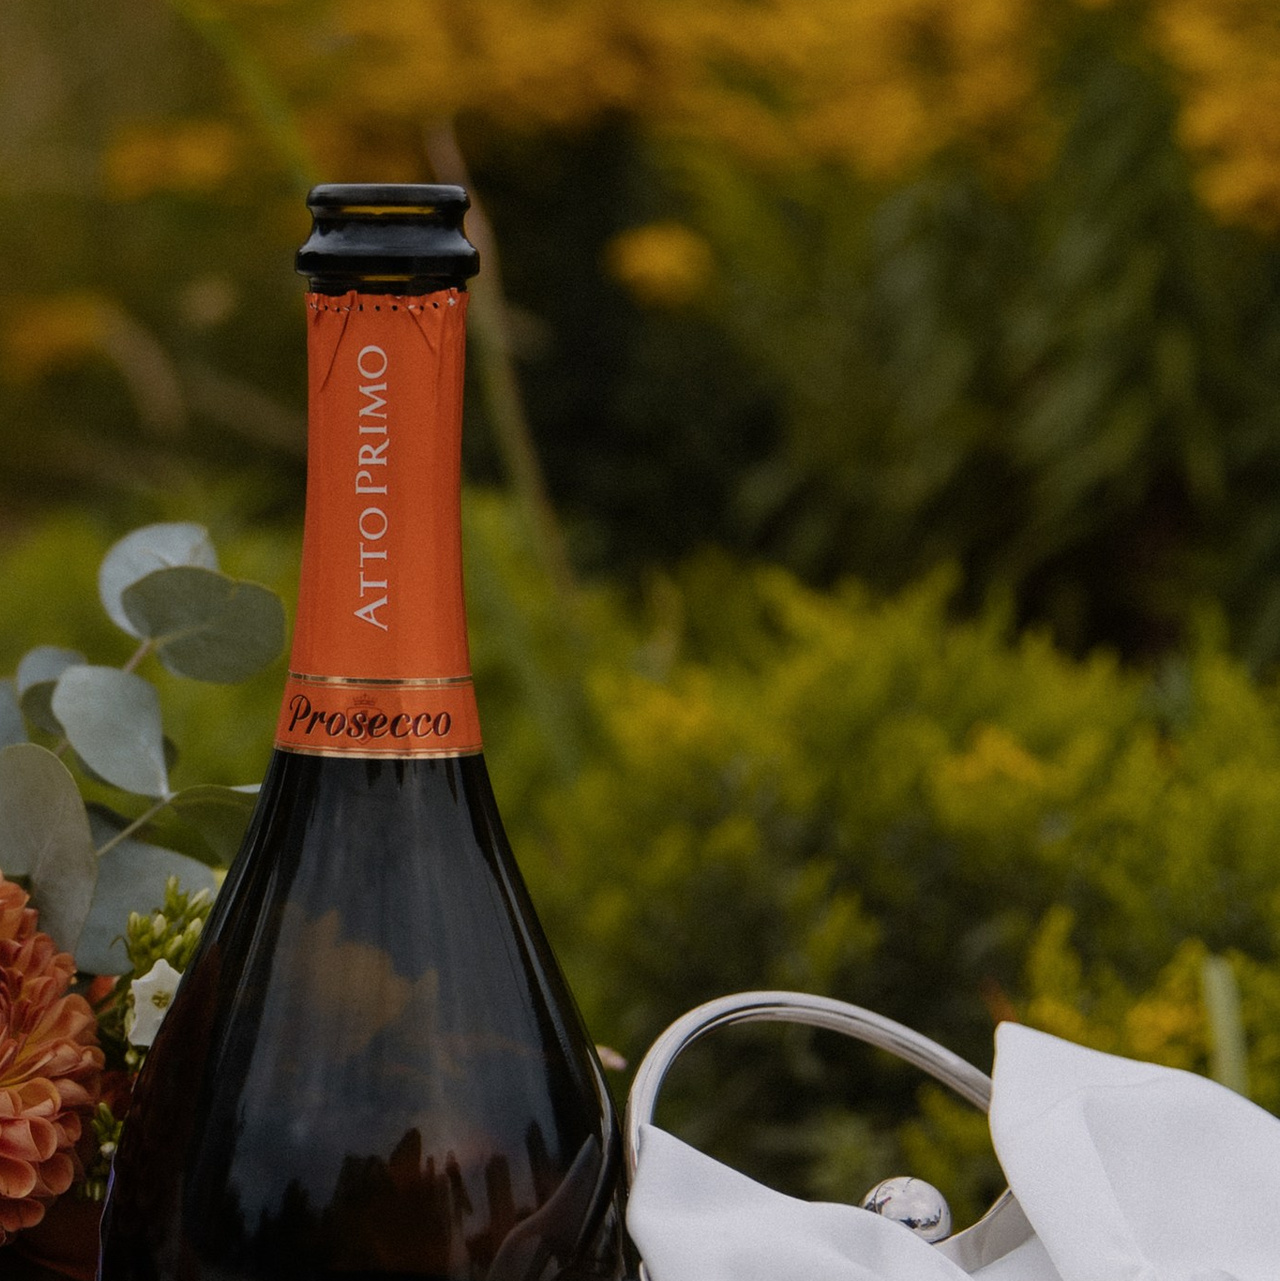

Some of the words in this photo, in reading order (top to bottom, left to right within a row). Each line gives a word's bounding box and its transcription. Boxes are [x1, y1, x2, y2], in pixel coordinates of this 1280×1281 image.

[355, 344, 390, 495] PRIMO
[353, 506, 389, 631] ATTO
[287, 694, 452, 739] Prosecco
